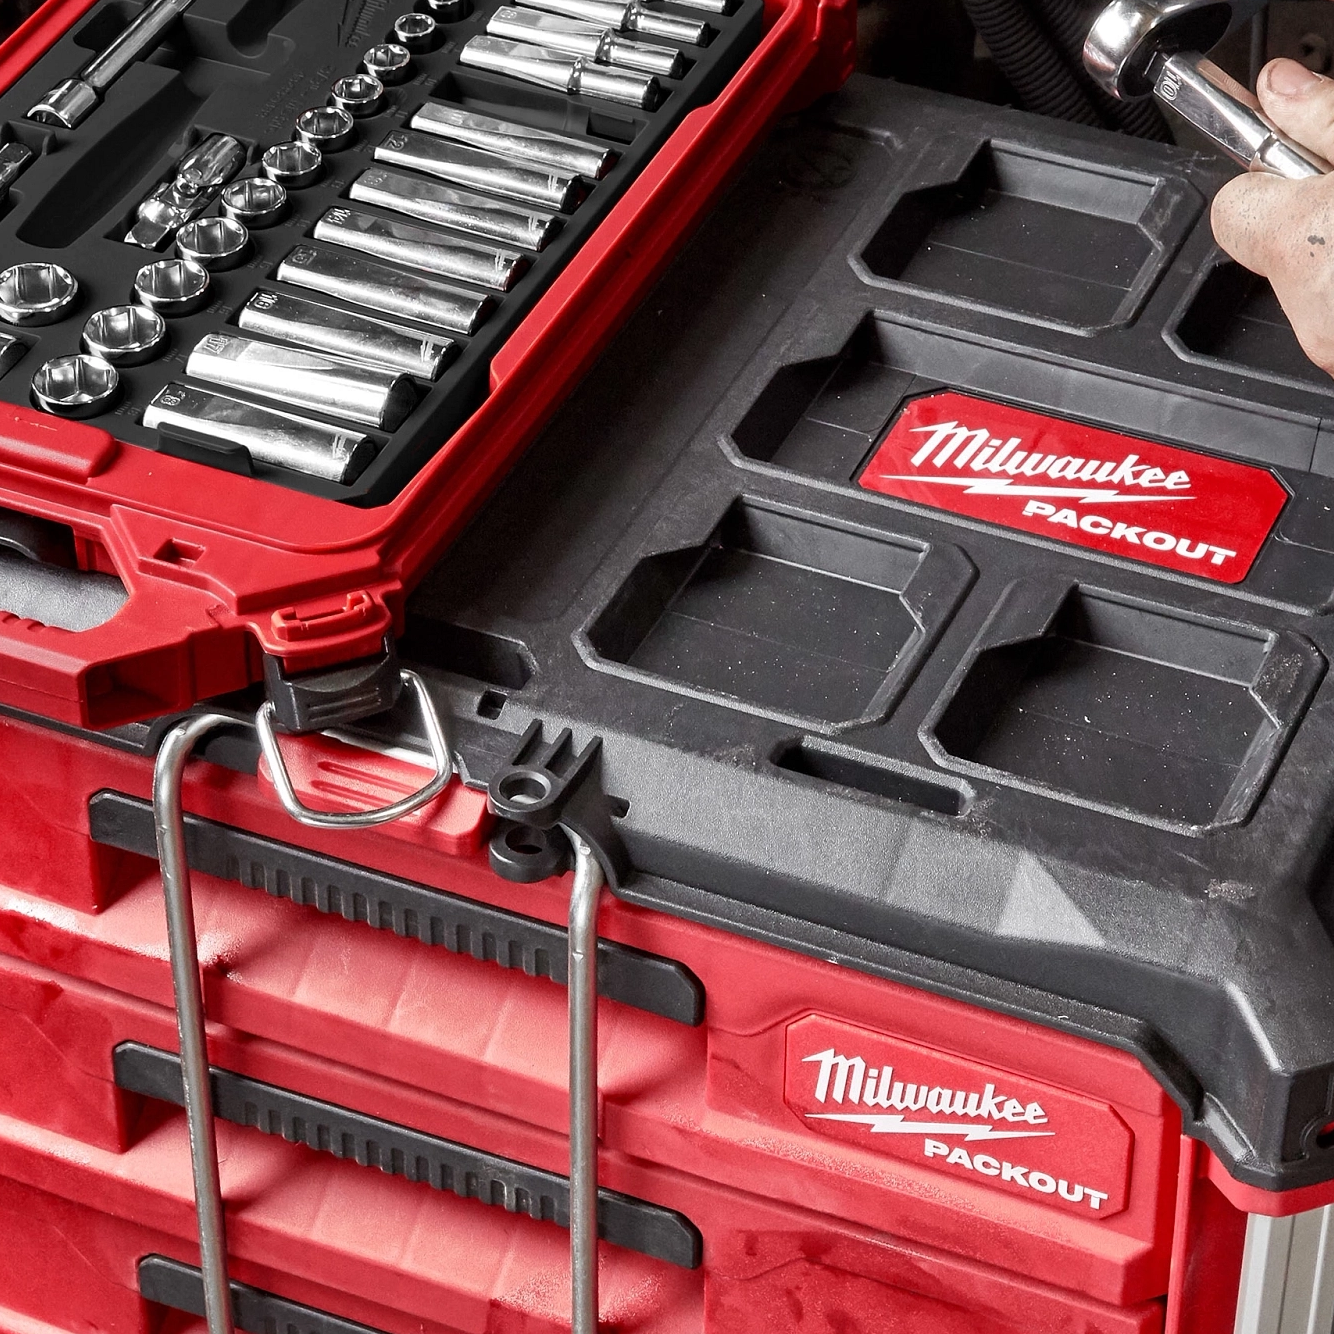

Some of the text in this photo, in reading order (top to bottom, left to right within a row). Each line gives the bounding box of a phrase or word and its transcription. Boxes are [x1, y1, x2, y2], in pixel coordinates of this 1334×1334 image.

[1159, 69, 1182, 100] 10
[909, 420, 1192, 490] Milwaukee
[1022, 499, 1237, 566] PACKOUT
[801, 1047, 1049, 1125] Milwaukee
[923, 1138, 1109, 1210] PACKOUT
